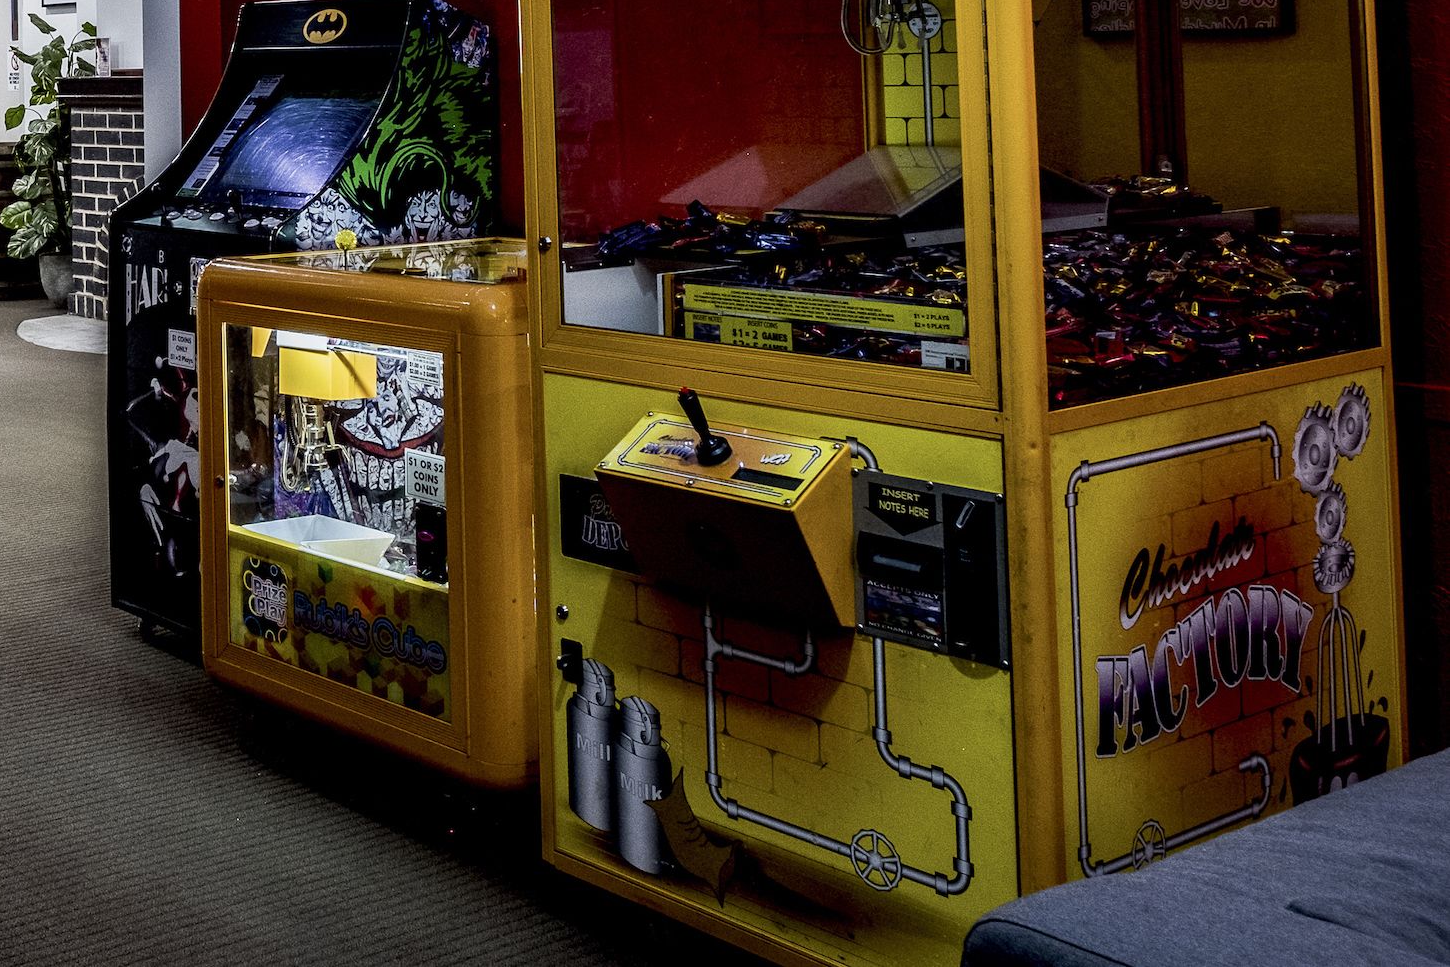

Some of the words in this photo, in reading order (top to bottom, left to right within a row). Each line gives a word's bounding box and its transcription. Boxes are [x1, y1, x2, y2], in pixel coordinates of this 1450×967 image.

[752, 330, 759, 340] 2
[761, 331, 788, 343] GAMES
[176, 345, 188, 353] ONLY
[408, 456, 417, 467] $1
[420, 459, 432, 471] OR
[433, 462, 444, 474] $2
[413, 470, 439, 485] COINS
[414, 482, 439, 497] ONLY
[881, 487, 921, 503] INSERT
[878, 499, 907, 515] NOTES
[908, 505, 930, 520] HERE
[581, 514, 631, 552] DEP
[1119, 514, 1256, 631] Chocolate
[250, 576, 288, 604] Prize
[913, 589, 940, 600] ONLY
[256, 596, 288, 626] Play
[293, 590, 371, 652] Rubik's
[371, 615, 447, 675] Cube
[916, 632, 942, 643] GIVEN
[1095, 584, 1314, 758] FACTORY
[620, 771, 663, 802] Milk
